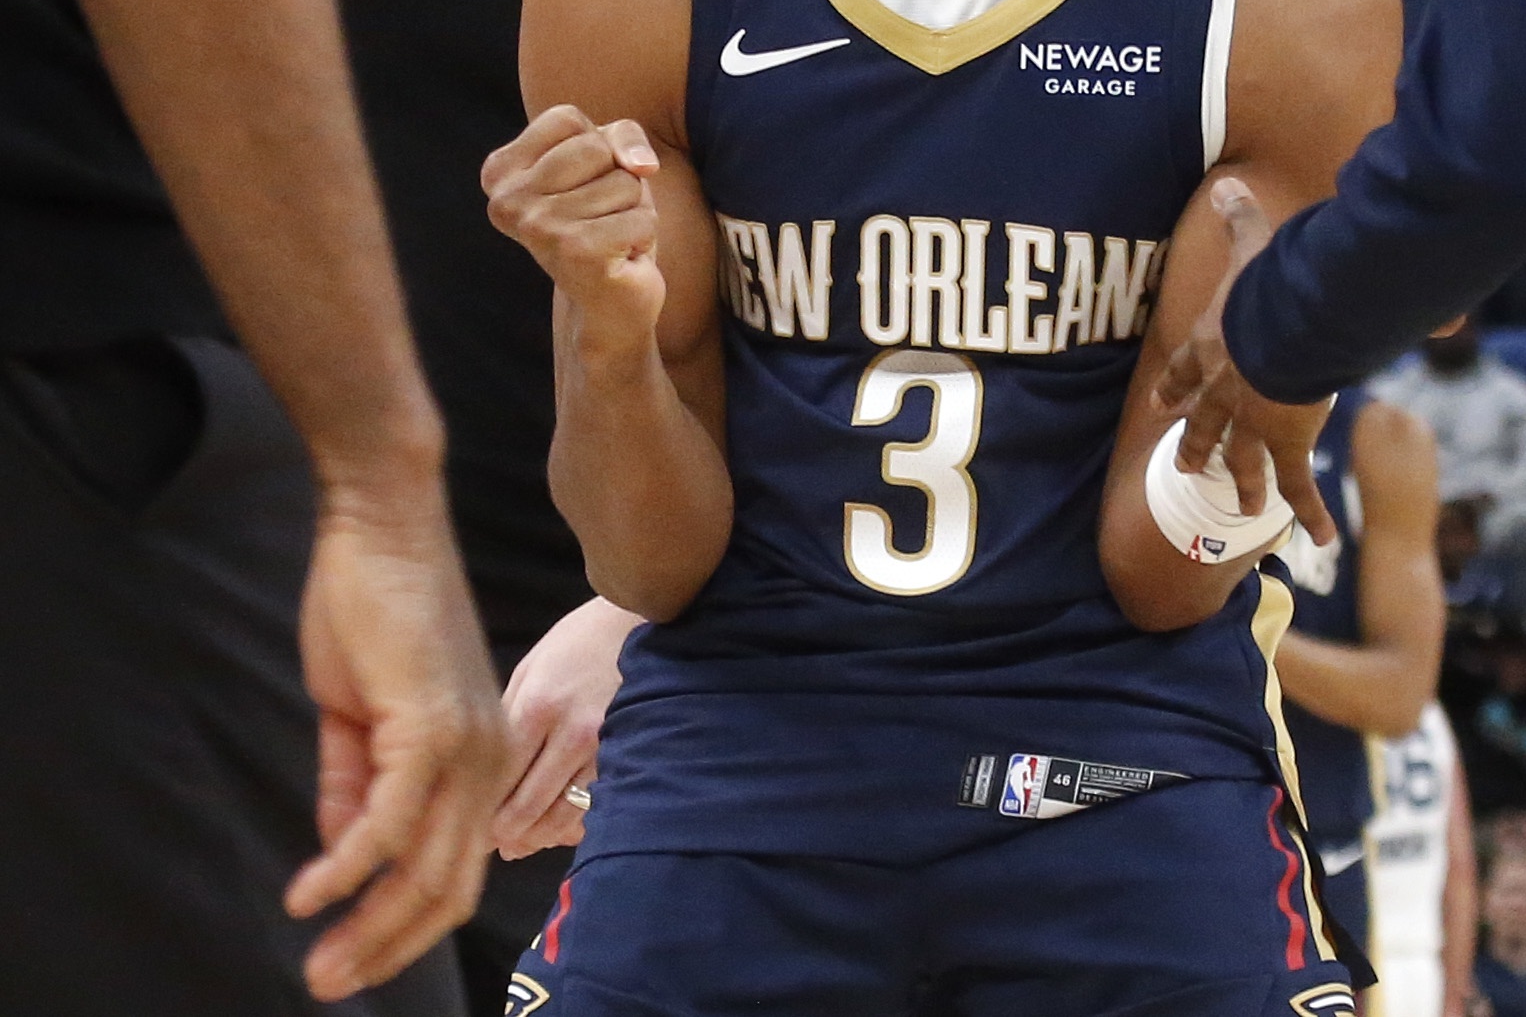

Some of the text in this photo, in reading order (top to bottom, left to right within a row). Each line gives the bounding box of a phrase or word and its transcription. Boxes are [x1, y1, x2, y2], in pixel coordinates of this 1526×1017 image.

[1020, 43, 1162, 73] NEWAGE
[1044, 78, 1136, 96] GARAGE
[843, 349, 984, 596] 3
[1053, 773, 1072, 787] 46
